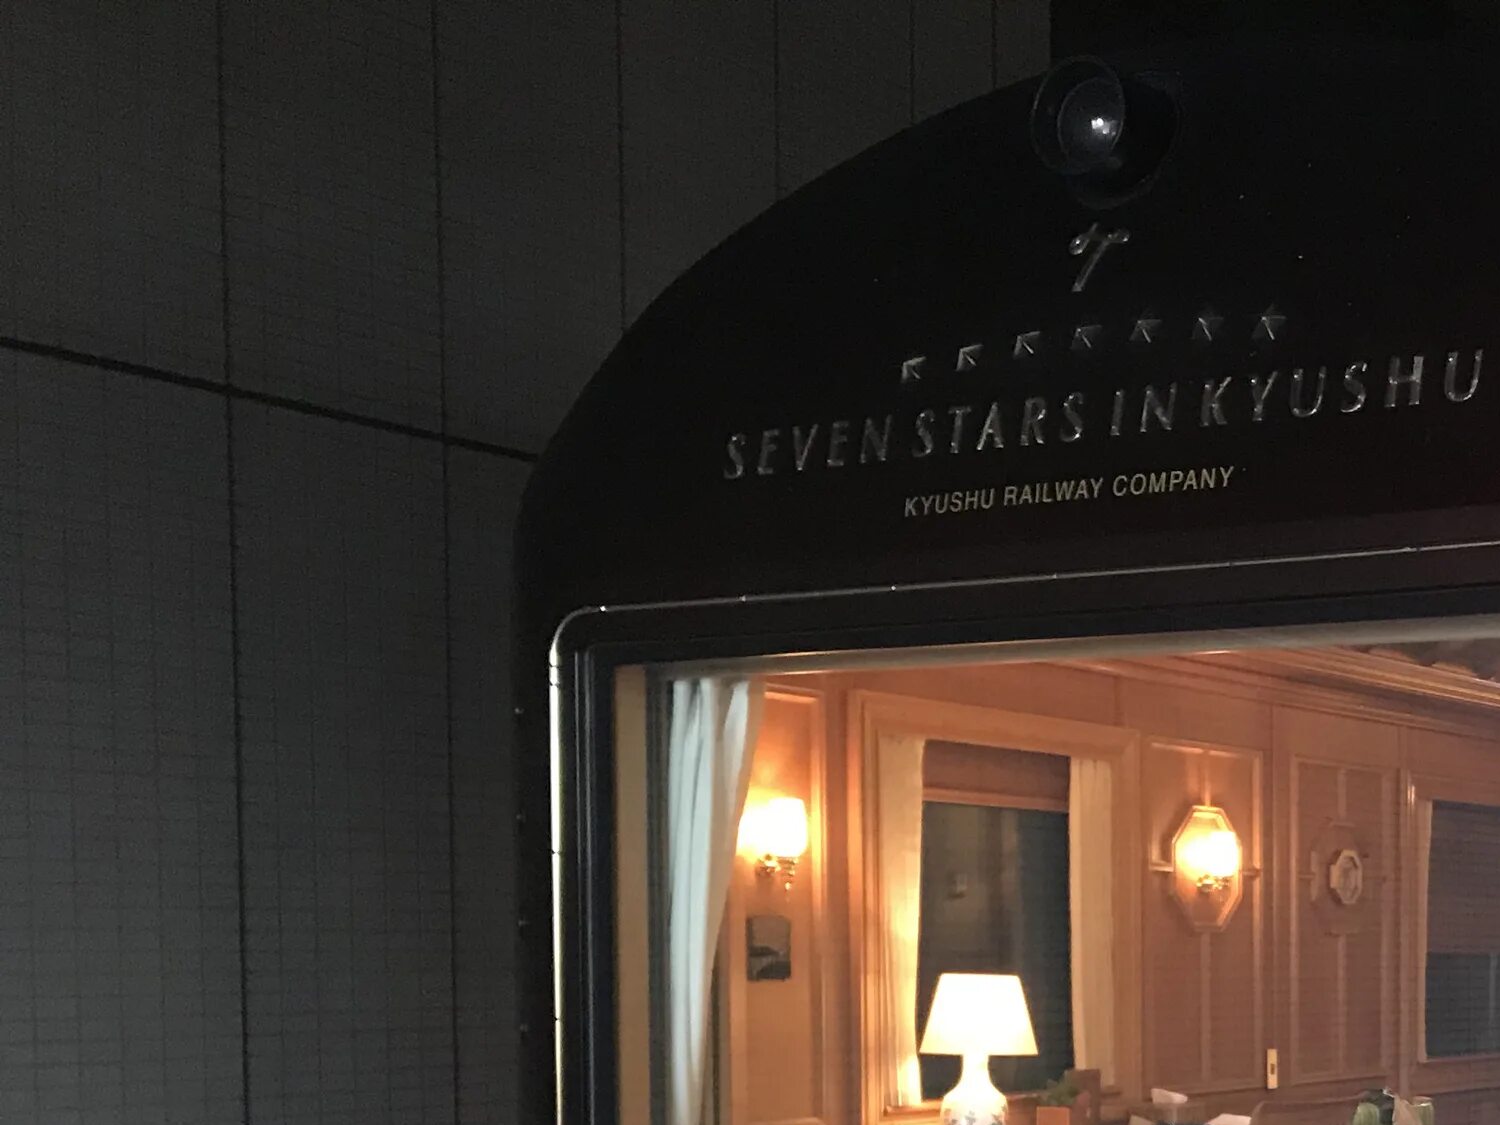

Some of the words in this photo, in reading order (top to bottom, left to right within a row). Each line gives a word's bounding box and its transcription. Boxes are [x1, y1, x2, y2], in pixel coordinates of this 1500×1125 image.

[723, 413, 894, 480] SEVEN
[911, 391, 1085, 458] STARS
[1109, 381, 1178, 437] IN
[1199, 348, 1484, 428] KYUSHU
[903, 488, 995, 518] KYUSHU
[1002, 476, 1105, 507] RAILWAY
[1111, 464, 1236, 498] COMPANY
